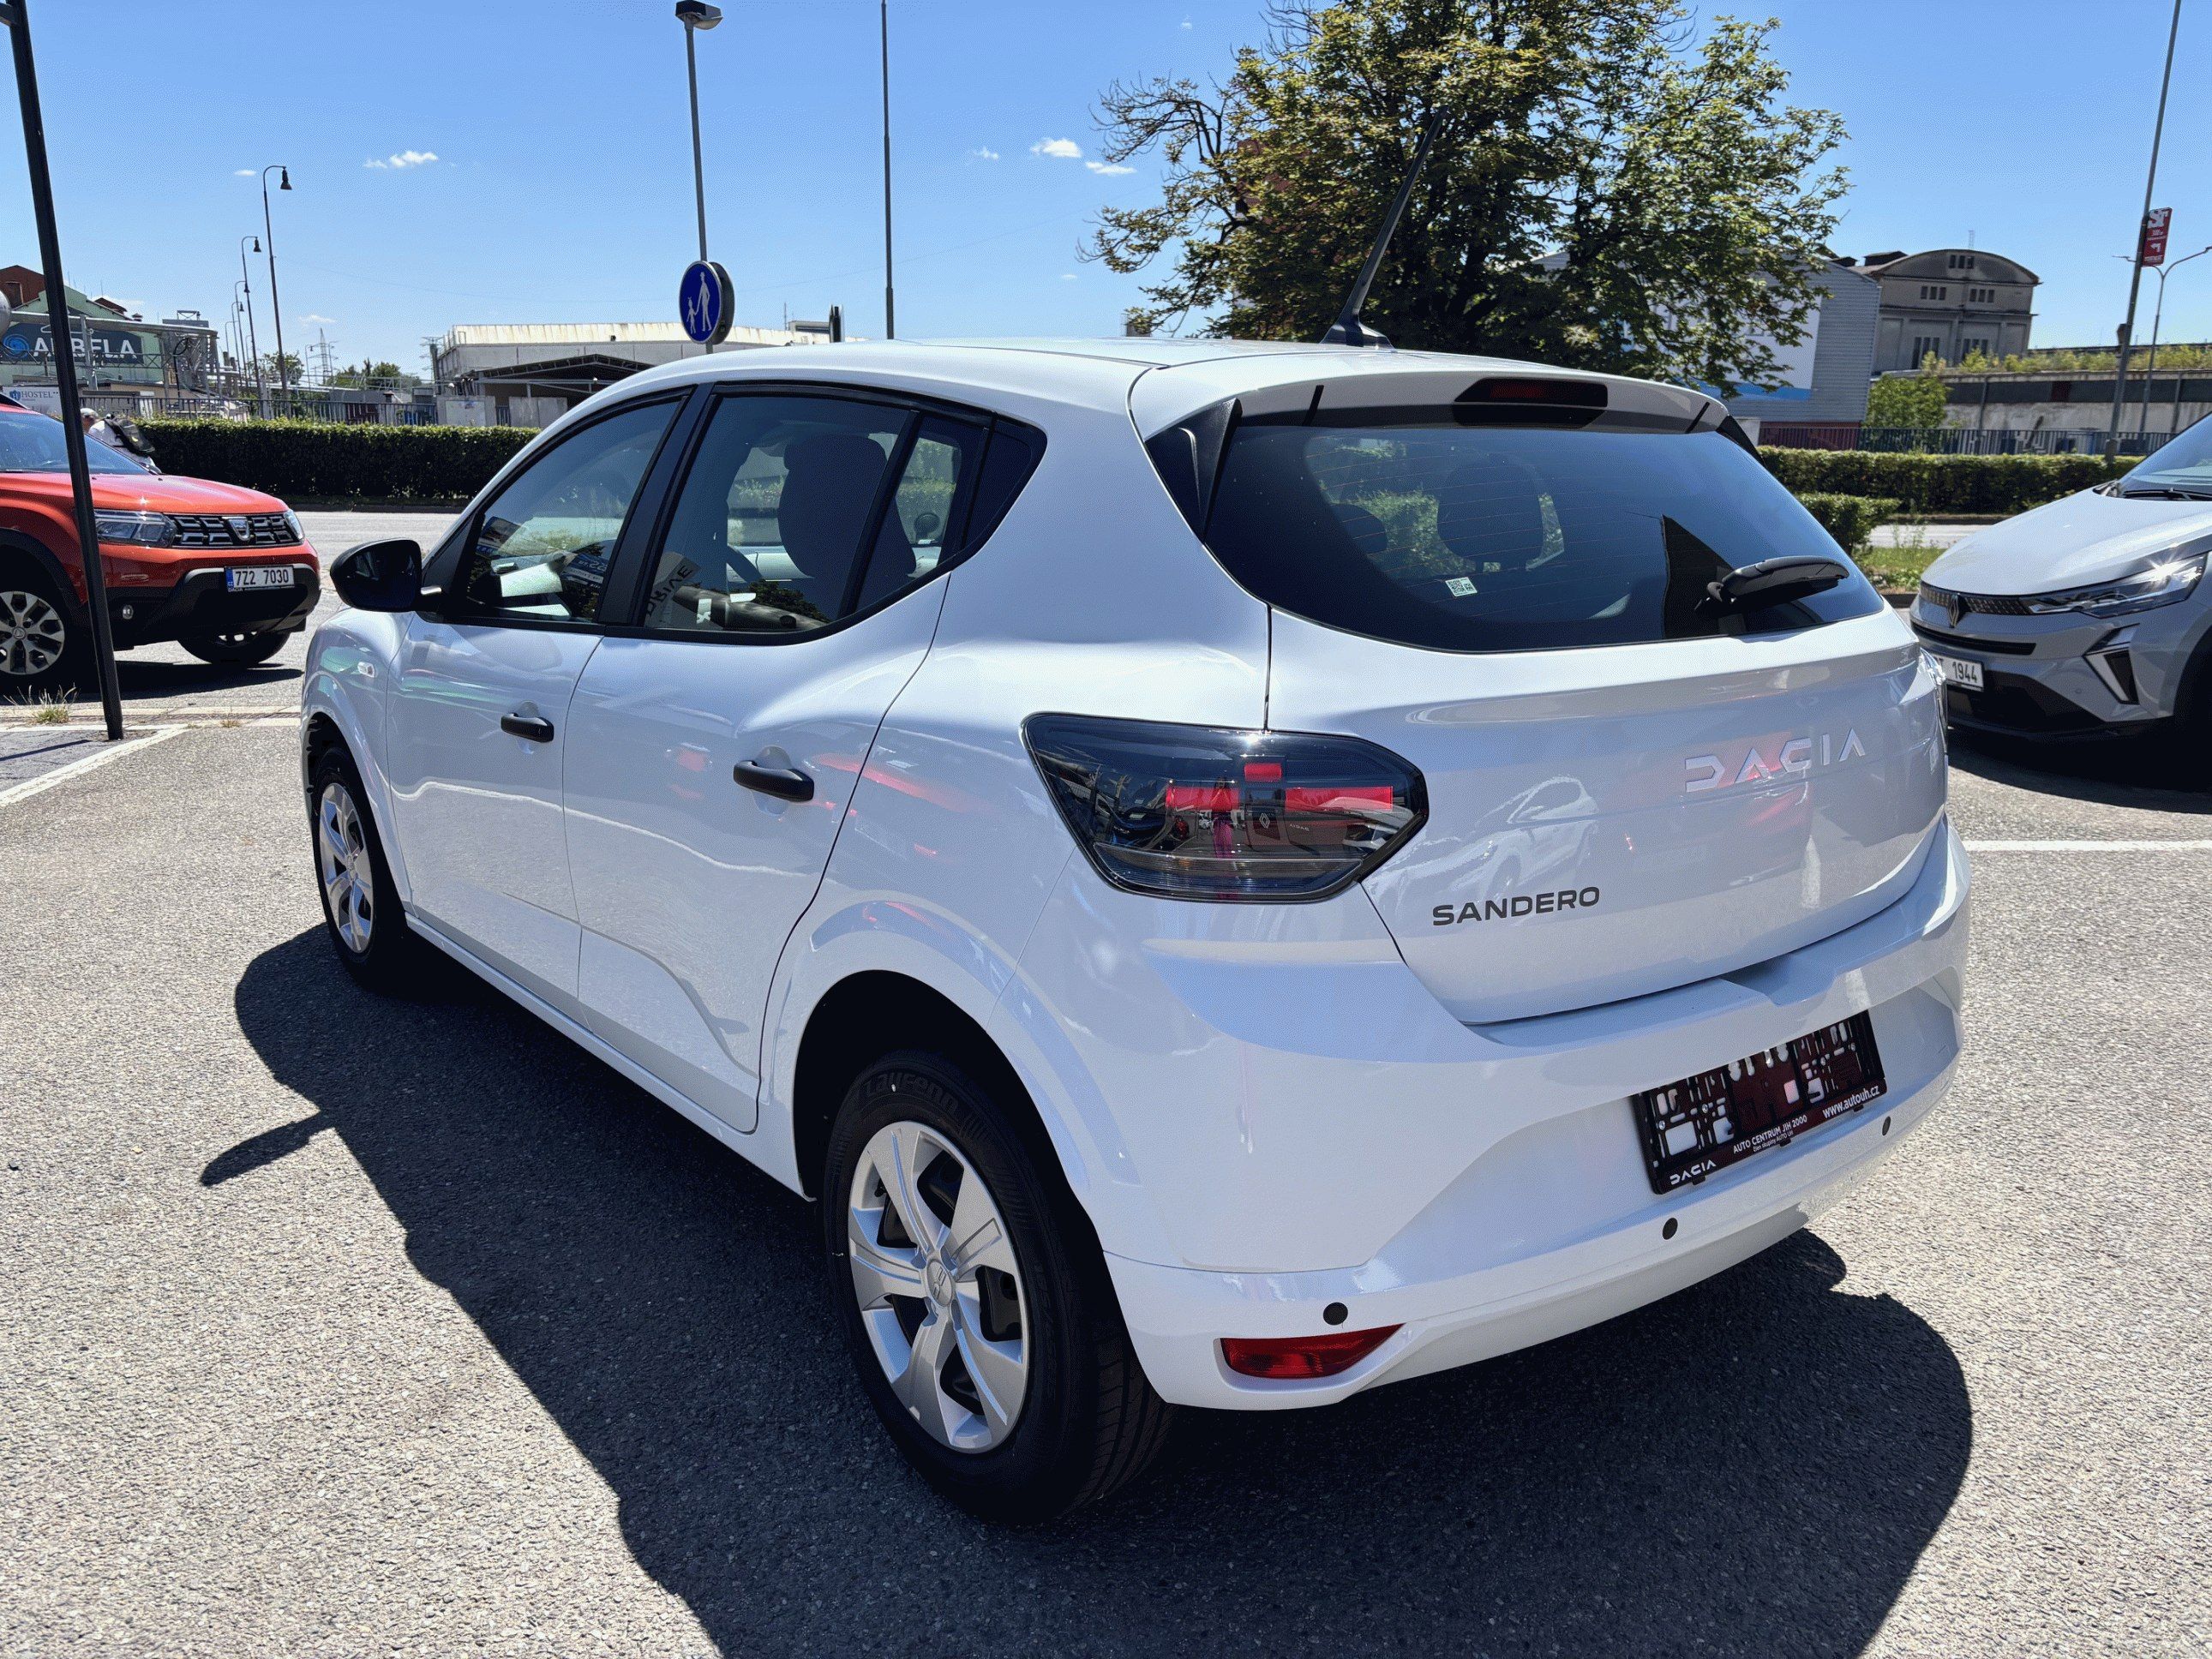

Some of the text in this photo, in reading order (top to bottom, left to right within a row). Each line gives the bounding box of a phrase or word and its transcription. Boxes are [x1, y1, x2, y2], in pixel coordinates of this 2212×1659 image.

[33, 337, 137, 358] ABELA
[236, 569, 289, 585] 7Z2 7030
[1952, 661, 1977, 683] 1944
[1685, 728, 1866, 793] DACIA
[1432, 886, 1600, 926] SANDERO
[1822, 1085, 1880, 1118] www.autouh.cz
[1733, 1140, 1751, 1154] AUTO
[1752, 1126, 1782, 1146] CENTRUM
[1792, 1115, 1807, 1128] 2000
[1669, 1159, 1717, 1185] DACIA
